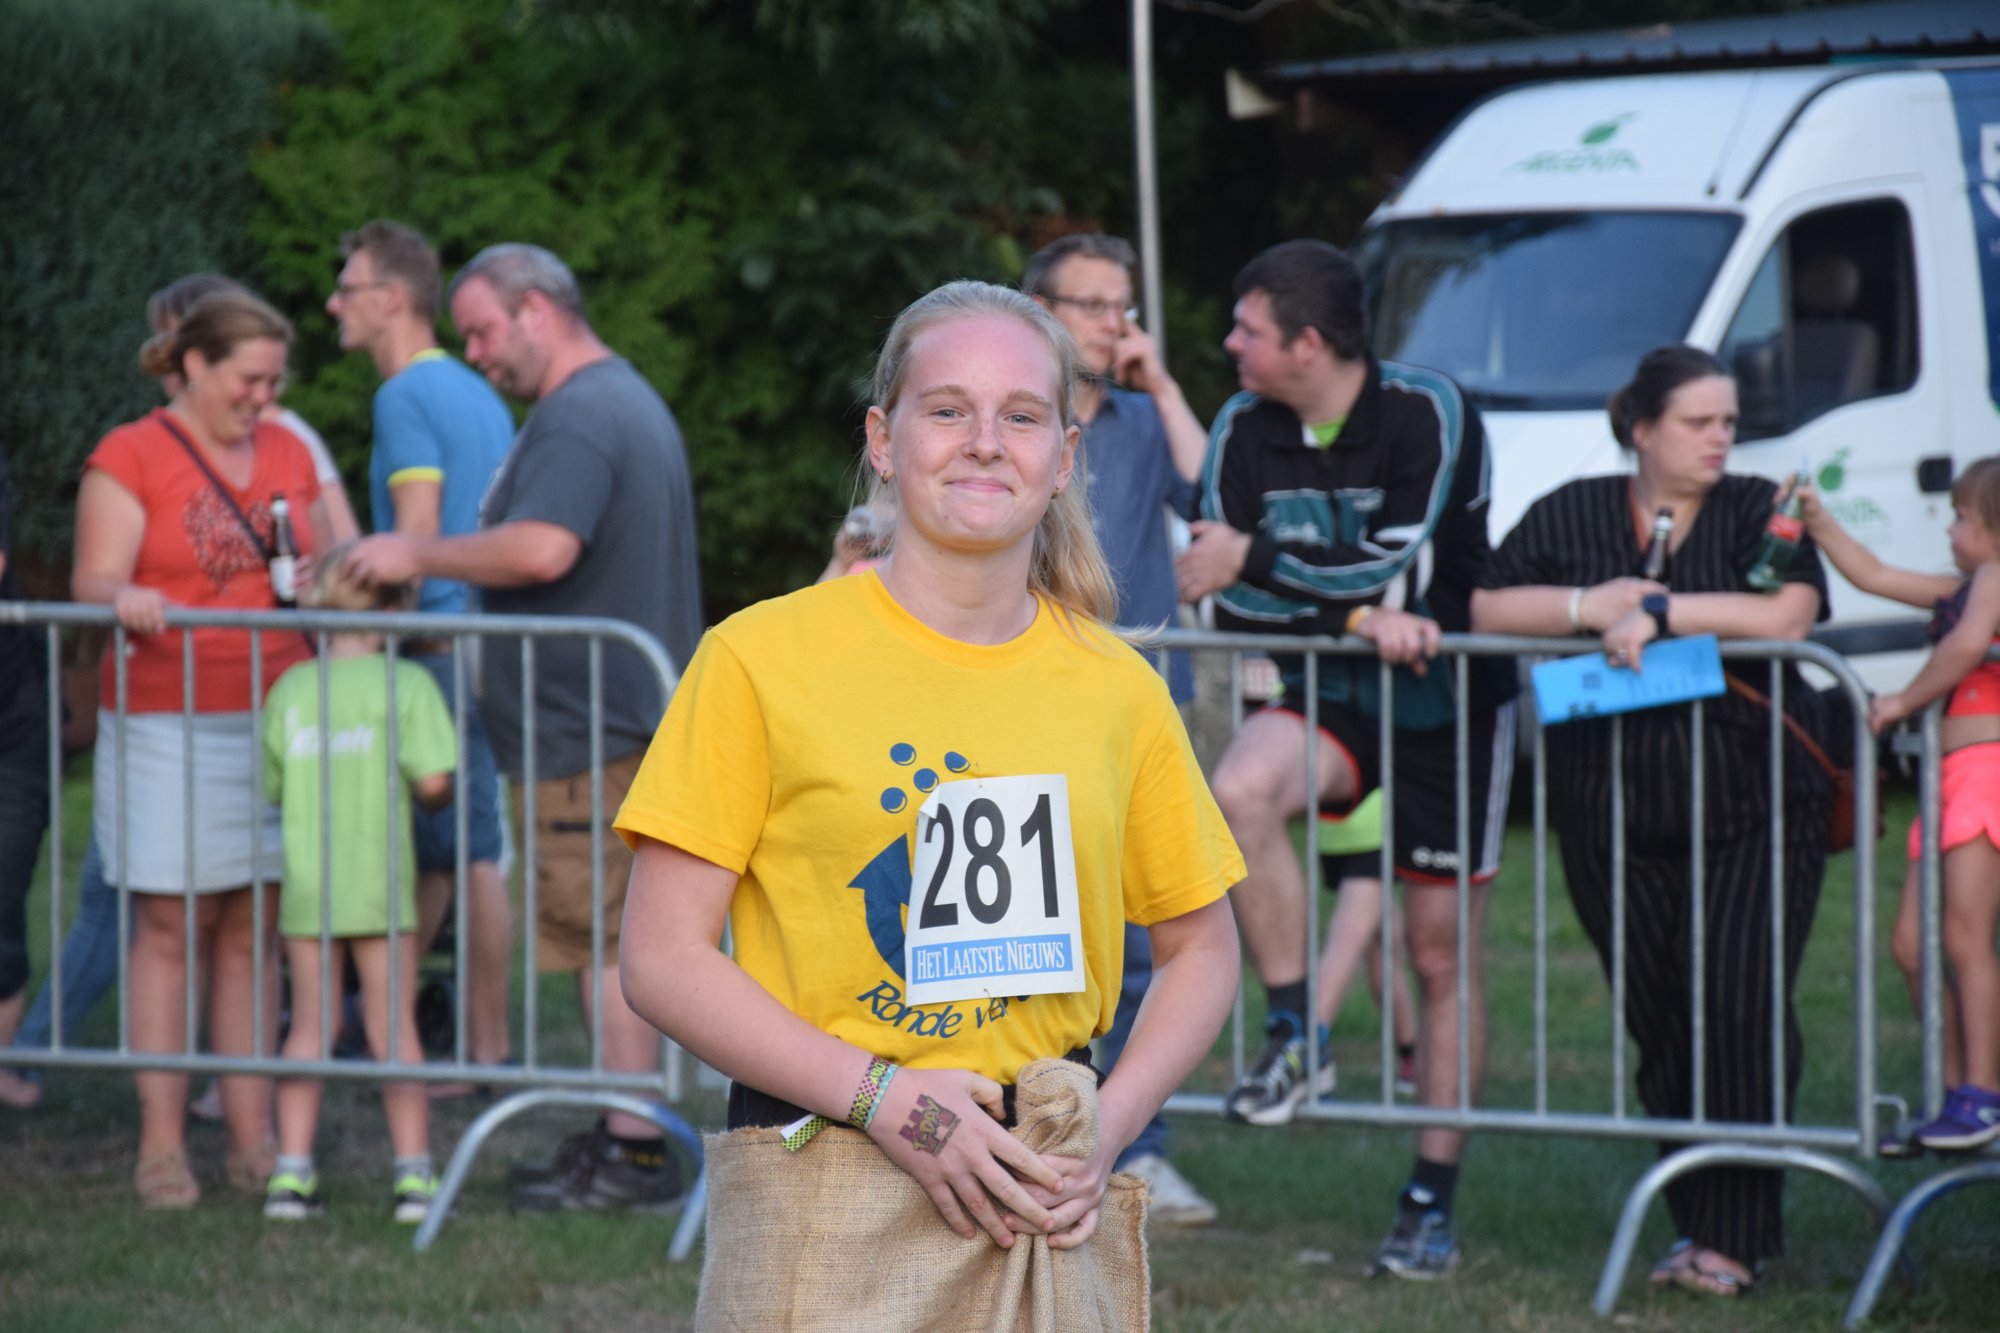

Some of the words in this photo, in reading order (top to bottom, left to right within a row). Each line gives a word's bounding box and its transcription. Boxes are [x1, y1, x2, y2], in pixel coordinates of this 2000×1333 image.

[919, 793, 1059, 930] 281
[917, 949, 942, 980] HET
[943, 945, 1005, 977] LAATSTE
[1005, 941, 1066, 971] NIEUWS
[857, 980, 963, 1039] Ronde
